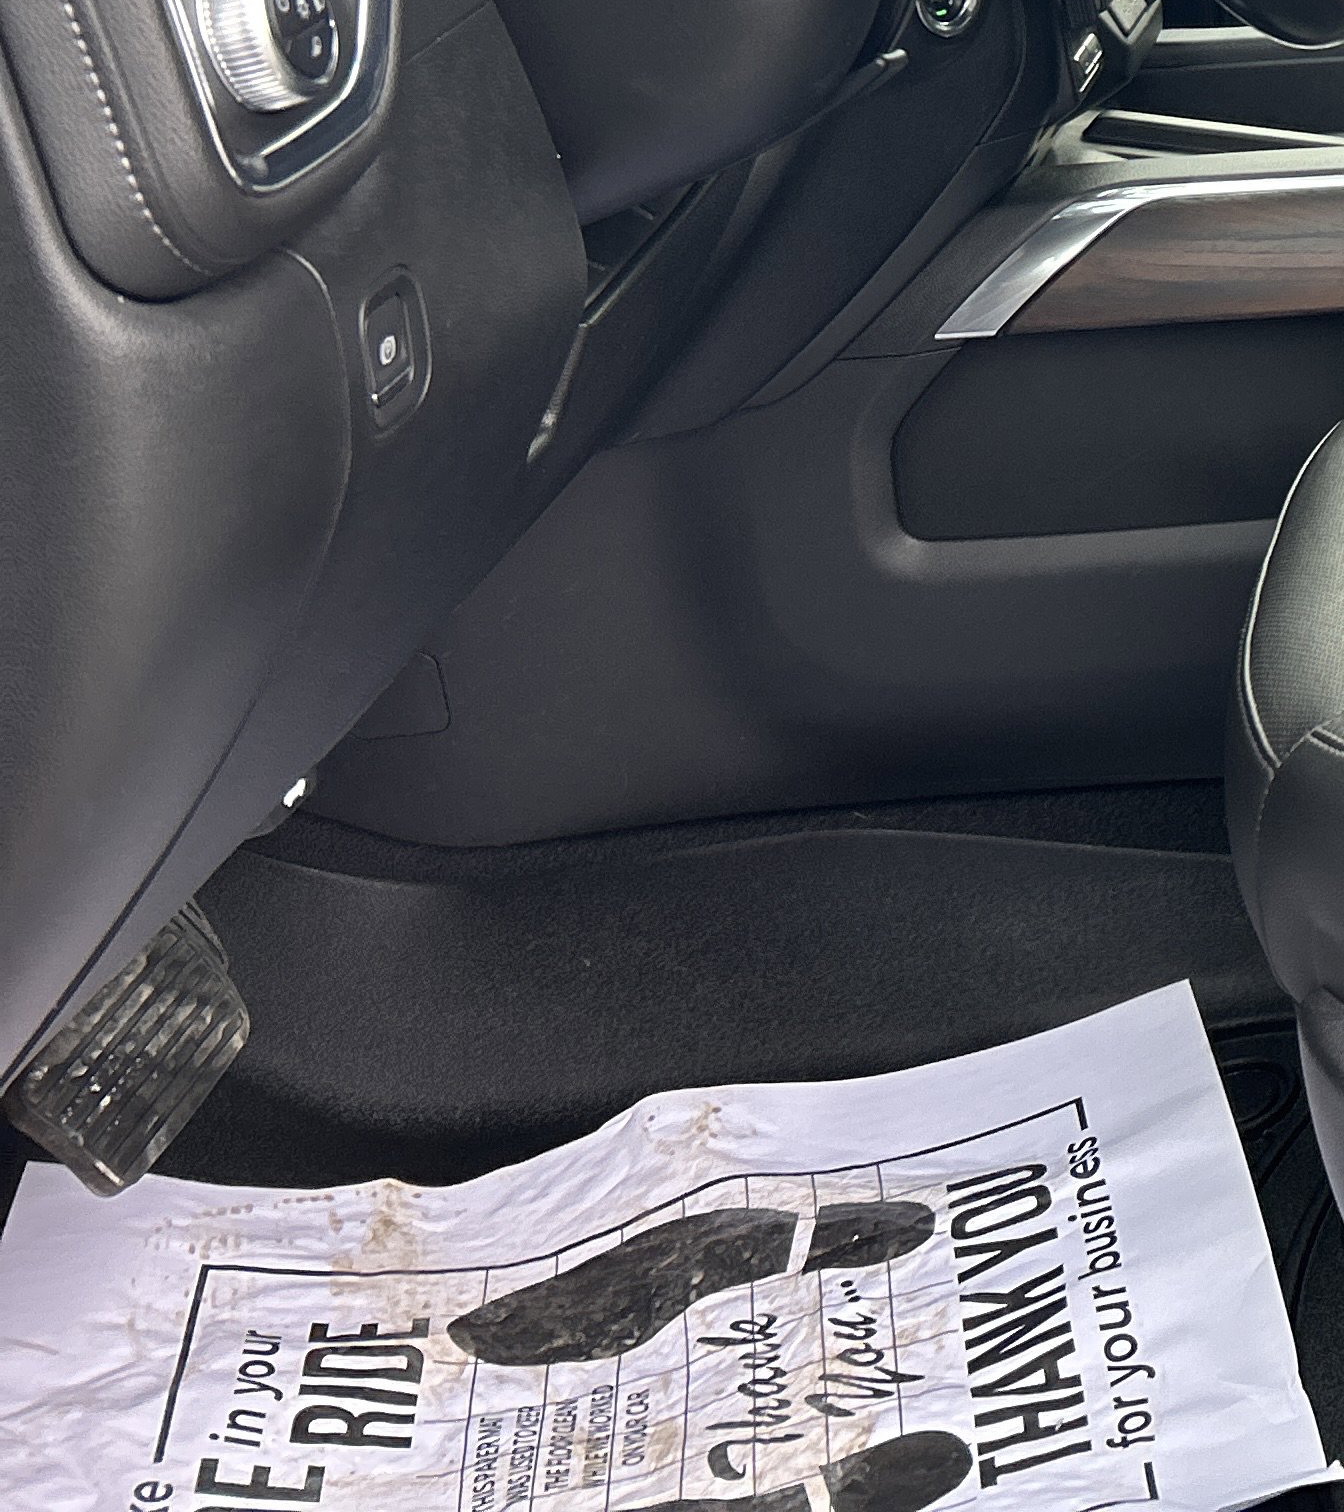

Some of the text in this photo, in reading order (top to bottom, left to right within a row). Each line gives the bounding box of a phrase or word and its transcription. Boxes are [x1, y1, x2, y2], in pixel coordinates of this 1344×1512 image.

[946, 1163, 1092, 1488] THANK YOU
[1066, 1135, 1156, 1450] for your business
[209, 1329, 283, 1448] in your
[289, 1317, 431, 1449] RIDE
[552, 1399, 579, 1434] CLEAN
[588, 1384, 614, 1434] WORKED
[622, 1388, 651, 1467] ON YOUR CAR
[696, 1312, 804, 1481] Thank
[544, 1467, 570, 1492] THE
